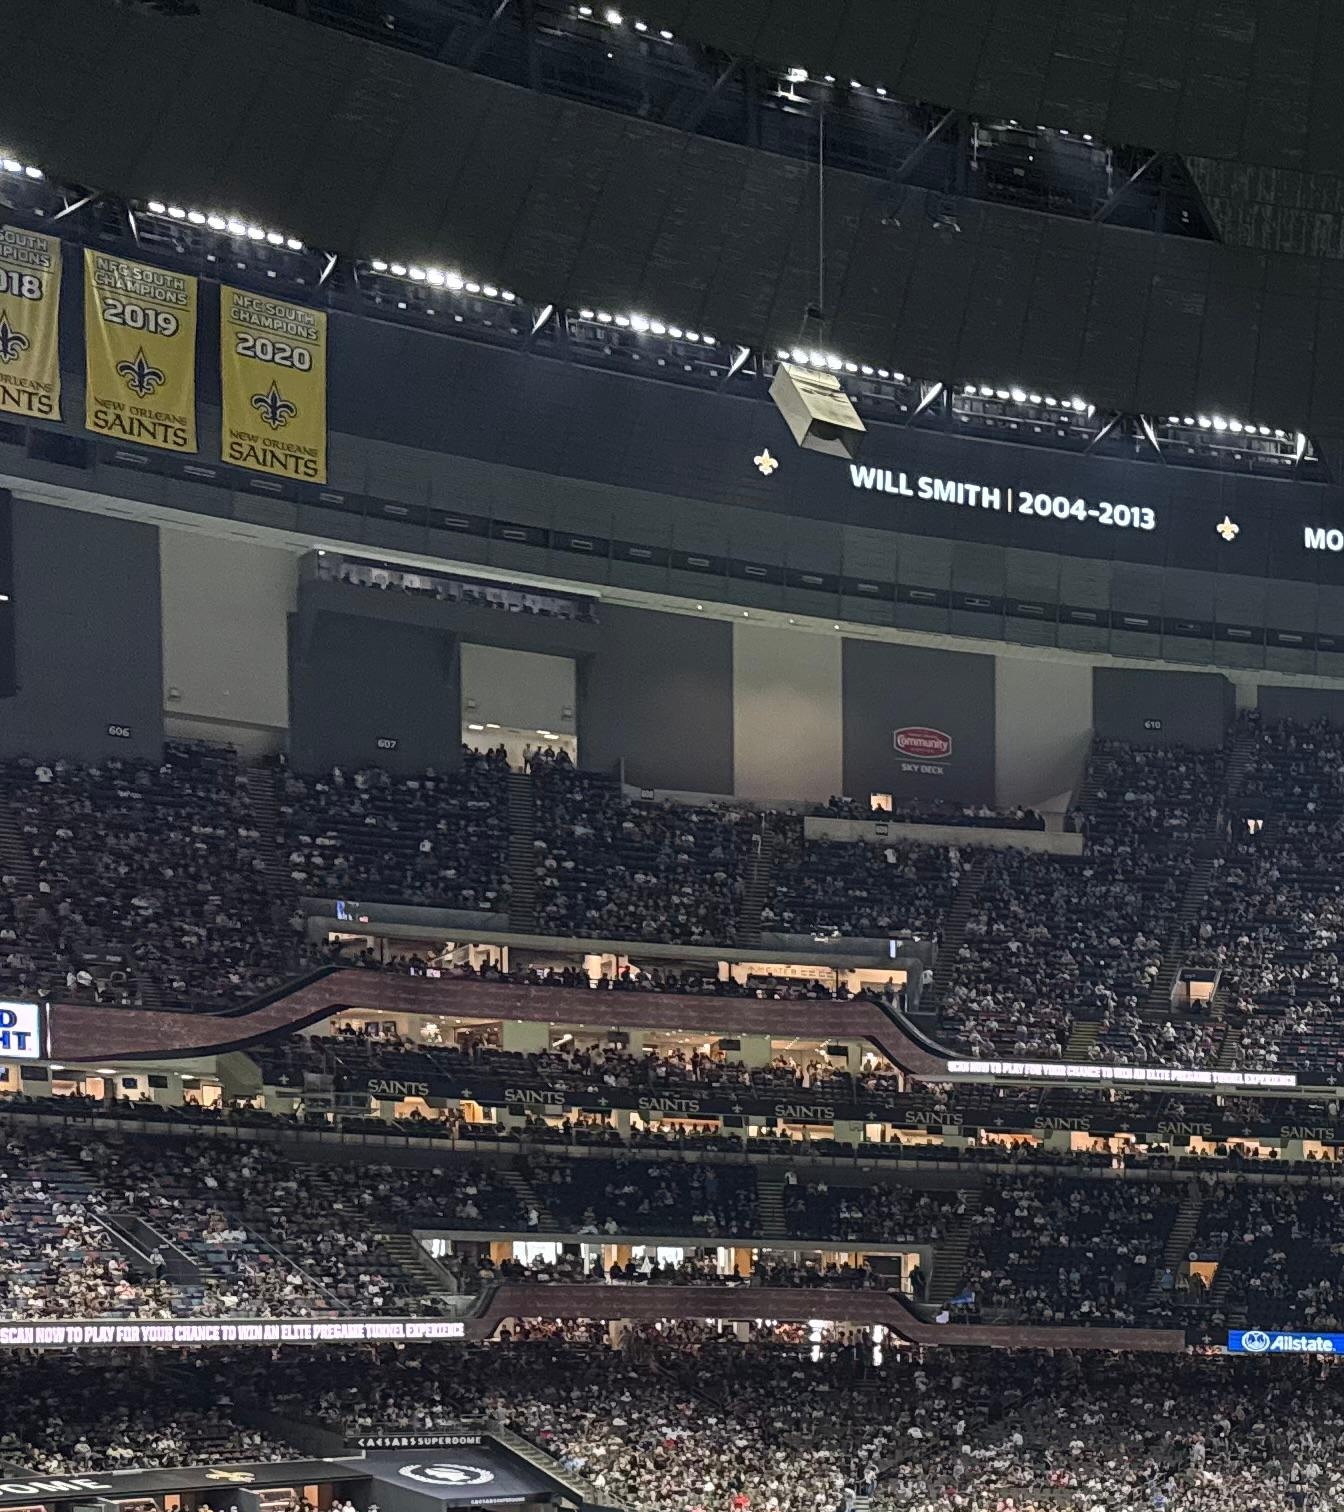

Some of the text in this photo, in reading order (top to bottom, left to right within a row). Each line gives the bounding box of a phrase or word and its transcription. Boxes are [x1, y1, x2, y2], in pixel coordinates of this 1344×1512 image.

[97, 257, 185, 291] NFC SOUTH
[94, 271, 188, 306] CHAMPIONS
[103, 298, 179, 338] 2019
[231, 293, 316, 326] NFC SOUTH
[230, 308, 318, 341] CHAMPIONS
[235, 332, 313, 373] 2020
[129, 406, 188, 426] ORLEANS
[93, 409, 188, 448] SAINTS
[262, 437, 319, 458] ORLEANS
[228, 441, 319, 479] SAINTS
[850, 464, 1156, 530] WILL SMITH 2004-2013
[109, 726, 130, 737] 606
[1144, 720, 1161, 729] 610
[378, 739, 397, 749] 607
[897, 734, 950, 752] Community
[902, 763, 944, 774] SKY DECK
[368, 1079, 428, 1096] SAINTS
[504, 1088, 564, 1105] SAINTS
[775, 1103, 834, 1120] SAINTS
[905, 1110, 963, 1127] SAINTS
[1158, 1122, 1212, 1136] SAINTS
[417, 1435, 482, 1447] SUPERDOME
